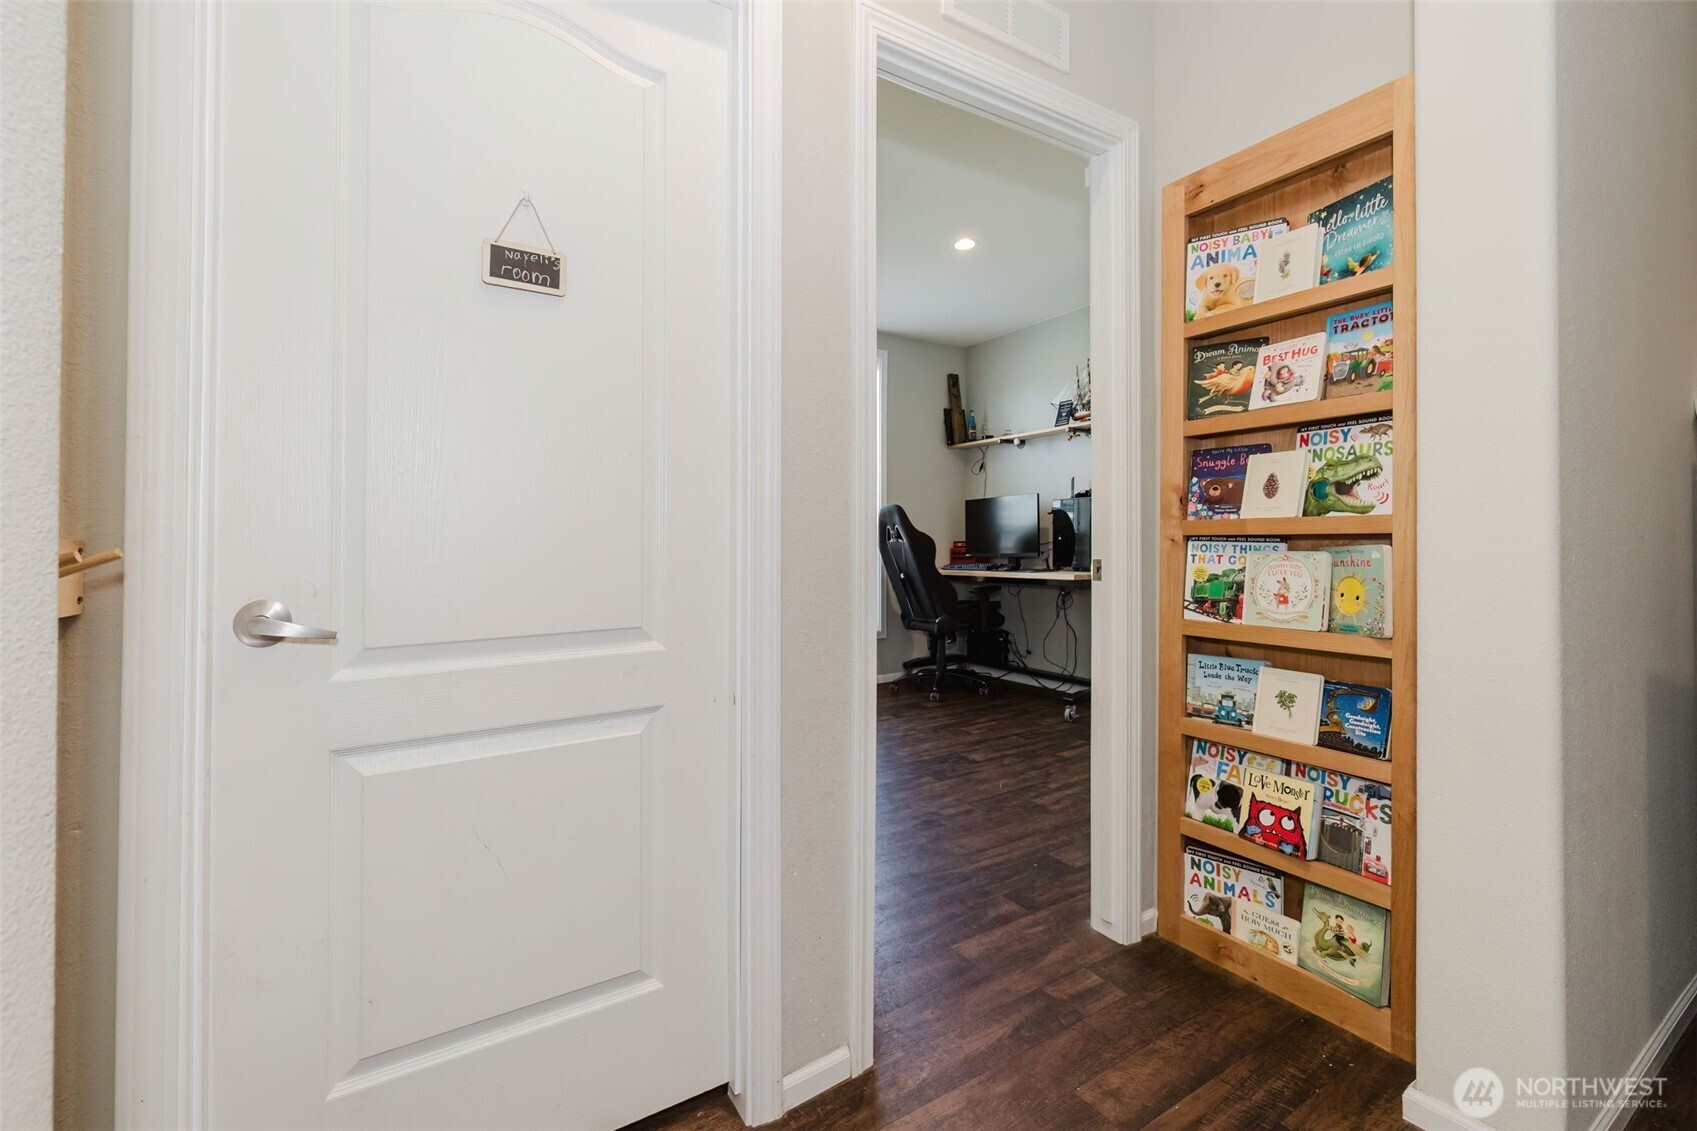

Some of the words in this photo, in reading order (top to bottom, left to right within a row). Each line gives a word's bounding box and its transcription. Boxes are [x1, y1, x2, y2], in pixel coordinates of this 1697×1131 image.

[1355, 193, 1389, 221] little
[1191, 238, 1229, 254] NOISY
[1233, 229, 1269, 246] BABY
[1324, 216, 1379, 252] Dreamer
[1191, 243, 1258, 270] ANIMA
[501, 265, 551, 287] room
[1334, 317, 1346, 325] THE
[1350, 311, 1370, 321] BUSY
[1373, 306, 1393, 315] LITTL
[1194, 349, 1226, 364] Dream
[1262, 350, 1291, 367] BEST
[1291, 345, 1318, 361] HUG
[1299, 427, 1352, 448] NOISY
[1196, 454, 1236, 470] Snuggle
[1308, 440, 1393, 463] NOSAURS
[1367, 478, 1390, 491] Roar!
[1190, 553, 1224, 565] THAT
[1228, 555, 1247, 565] GO
[1191, 543, 1228, 554] NOISY
[1333, 555, 1372, 567] unshine
[1198, 660, 1217, 670] Little
[1219, 662, 1235, 671] Blue
[1236, 664, 1259, 676] Truck
[1203, 671, 1222, 679] Leads
[1225, 673, 1235, 681] the
[1237, 675, 1252, 684] Way
[1196, 740, 1248, 765] NOISY
[1216, 761, 1242, 785] FA
[1295, 761, 1352, 790] NOISY
[1273, 780, 1310, 801] Monster
[1323, 786, 1392, 824] RUCKS
[1190, 857, 1242, 882] NOISY
[1243, 864, 1261, 873] SOUND
[1190, 872, 1275, 908] ANIMALS
[1240, 914, 1261, 927] HOW
[1264, 924, 1292, 940] MUCH
[1251, 911, 1280, 928] GUESS
